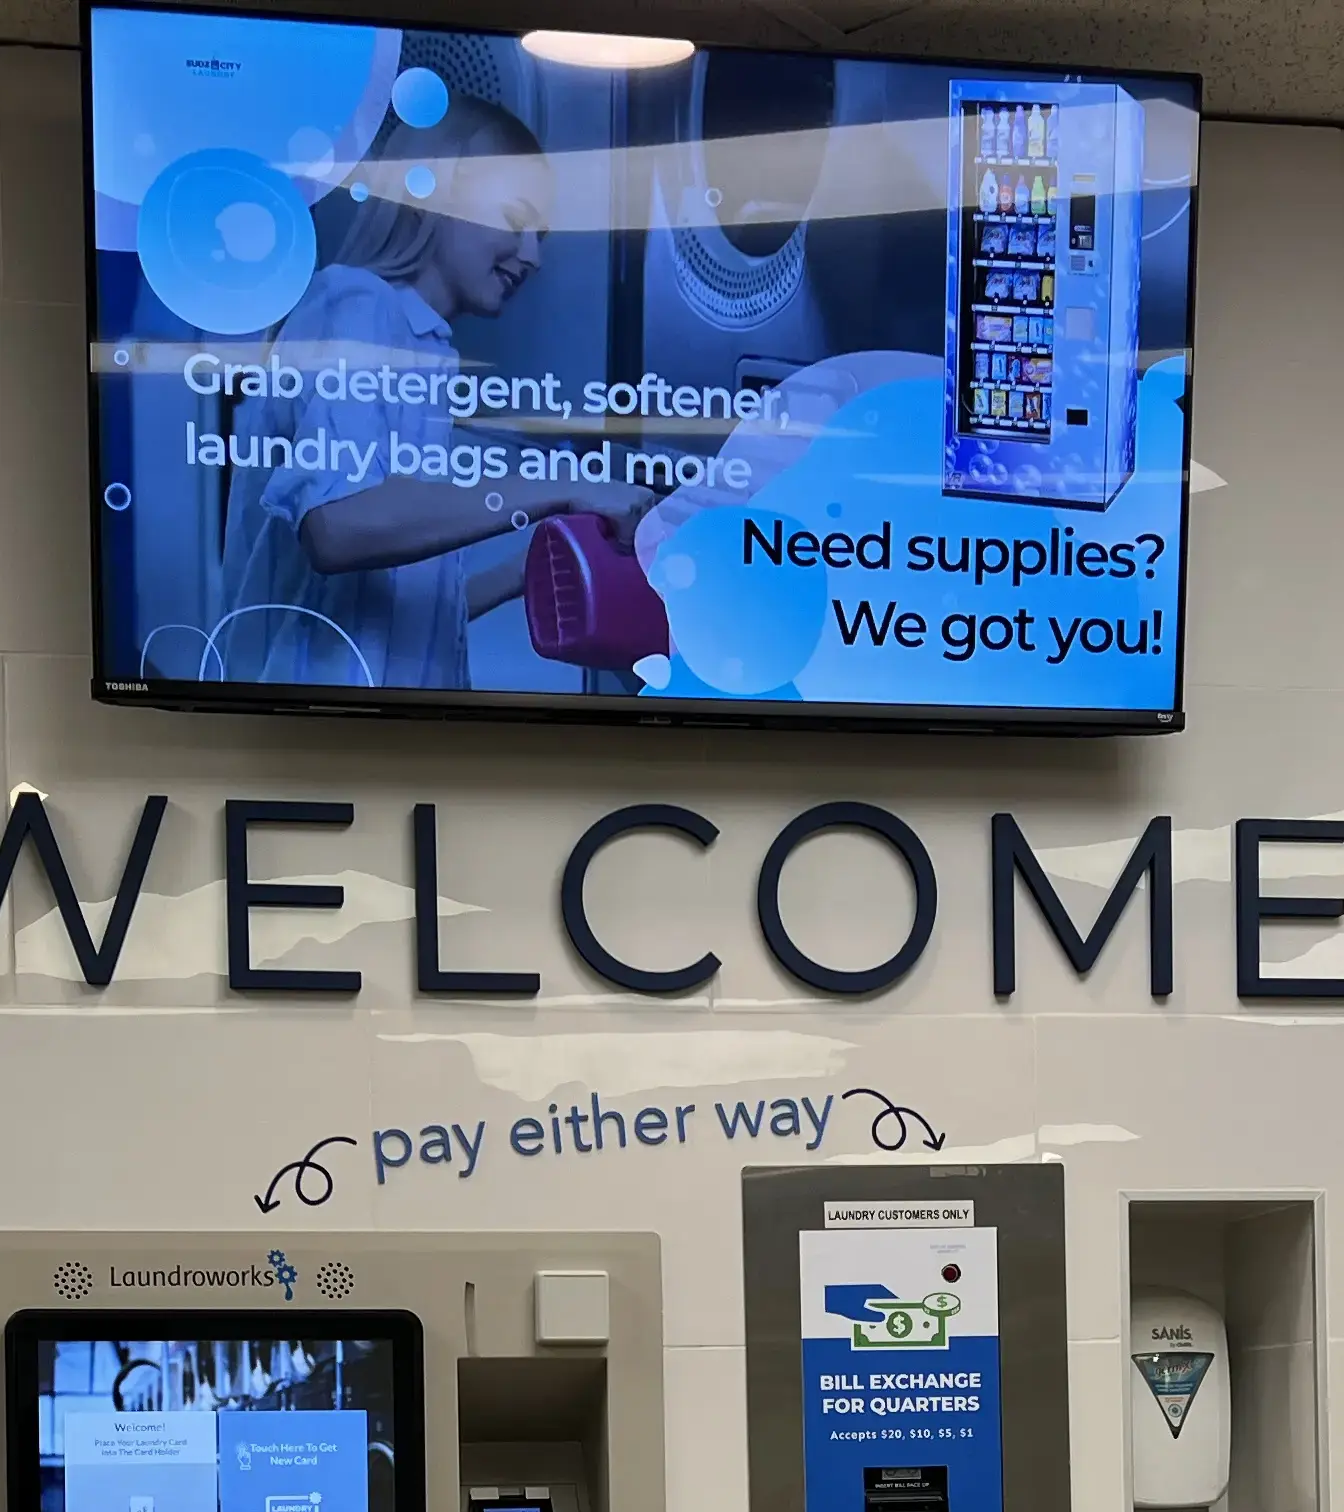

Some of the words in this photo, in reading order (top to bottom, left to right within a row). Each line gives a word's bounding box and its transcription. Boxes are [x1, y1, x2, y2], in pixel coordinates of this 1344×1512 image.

[183, 353, 304, 399] Grab
[315, 358, 573, 420] detergent,
[582, 372, 790, 430] softener,
[185, 421, 378, 483] laundry
[389, 430, 509, 488] bags
[518, 440, 611, 484] and
[625, 451, 752, 489] more
[742, 518, 892, 570] Need
[906, 526, 1166, 587] supplies?
[832, 599, 927, 648] We
[940, 608, 1036, 662] got
[1045, 609, 1163, 665] you!
[105, 682, 149, 692] TOSHIBA
[372, 1120, 486, 1185] pay
[509, 1092, 696, 1157] either
[714, 1094, 834, 1151] way
[828, 1210, 876, 1221] LAUNDRY
[878, 1209, 940, 1220] CUSTOMERS
[942, 1209, 969, 1220] ONLY
[110, 1265, 275, 1287] Laundroworks
[820, 1374, 865, 1390] BILL
[869, 1373, 982, 1390] EXCHANGE
[822, 1398, 865, 1414] FOR
[869, 1396, 981, 1416] QUARTERS
[114, 1422, 166, 1432] Welcome!
[168, 1438, 188, 1446] Card
[830, 1430, 877, 1442] Accepts
[881, 1429, 906, 1440] $20,
[909, 1428, 935, 1440] $10,
[938, 1428, 956, 1439] $5,
[960, 1428, 974, 1438] $1
[250, 1443, 279, 1453] Touch
[280, 1443, 304, 1452] Here
[306, 1443, 317, 1452] To
[318, 1442, 338, 1452] Get
[270, 1456, 293, 1465] New
[294, 1455, 318, 1466] Card
[271, 1505, 313, 1512] LAUNDRY
